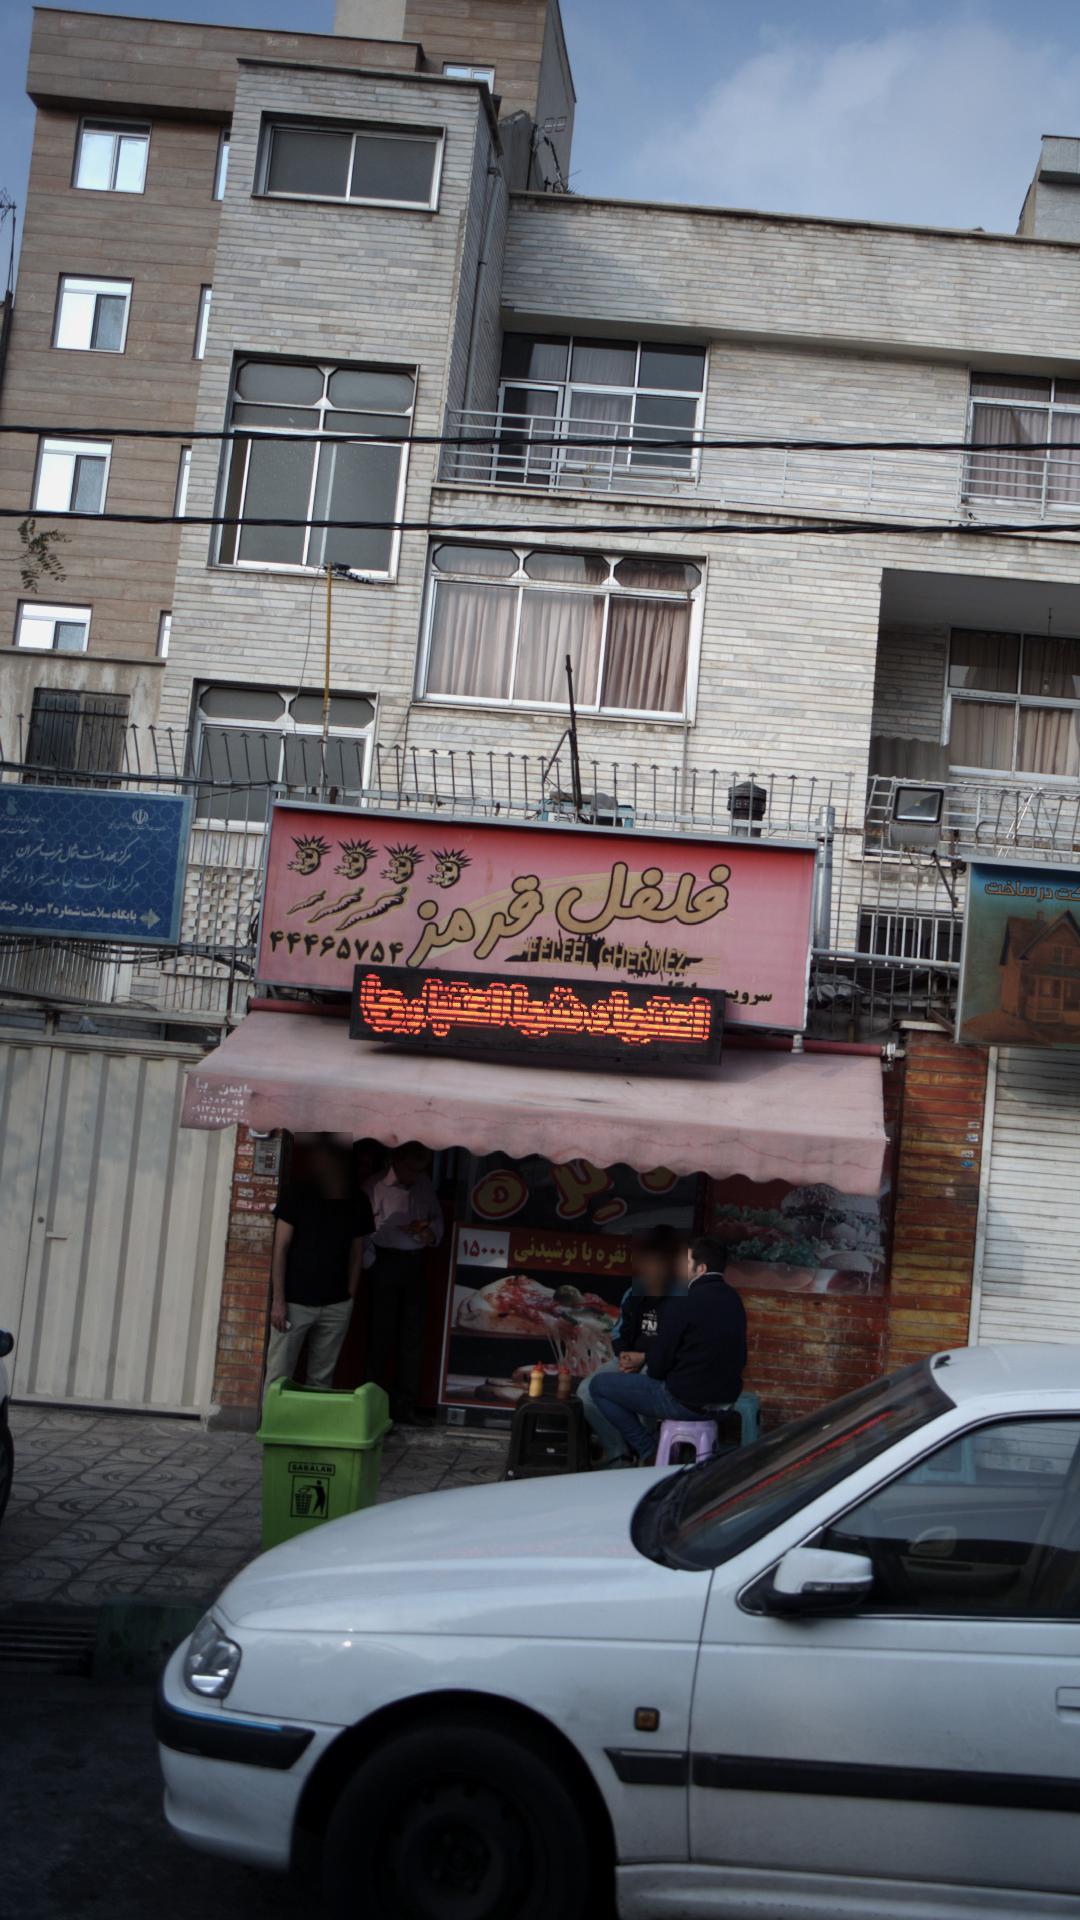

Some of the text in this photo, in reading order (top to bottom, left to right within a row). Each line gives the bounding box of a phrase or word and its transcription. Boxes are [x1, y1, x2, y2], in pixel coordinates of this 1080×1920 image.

[15, 835, 141, 867] مرکز بهداشت شمال غرب تهران
[14, 872, 50, 889] سردار
[75, 872, 122, 895] سلامت
[121, 859, 152, 895] مرکز
[984, 880, 1037, 897] ساخت
[1039, 886, 1054, 901] در
[19, 902, 46, 916] سردار
[52, 905, 81, 919] شماره
[81, 904, 112, 919] سلامت
[111, 907, 138, 924] پایگاه
[406, 861, 732, 967] فلفل قرمز
[269, 930, 404, 964] ۴۴۴۶۵۷۵۴
[526, 938, 688, 974] FELFEL GHERMEZ
[462, 1239, 506, 1258] ۱۵۰۰۰
[513, 1237, 627, 1269] نفره با نوشیدنی
[292, 1464, 333, 1473] SABALAN
